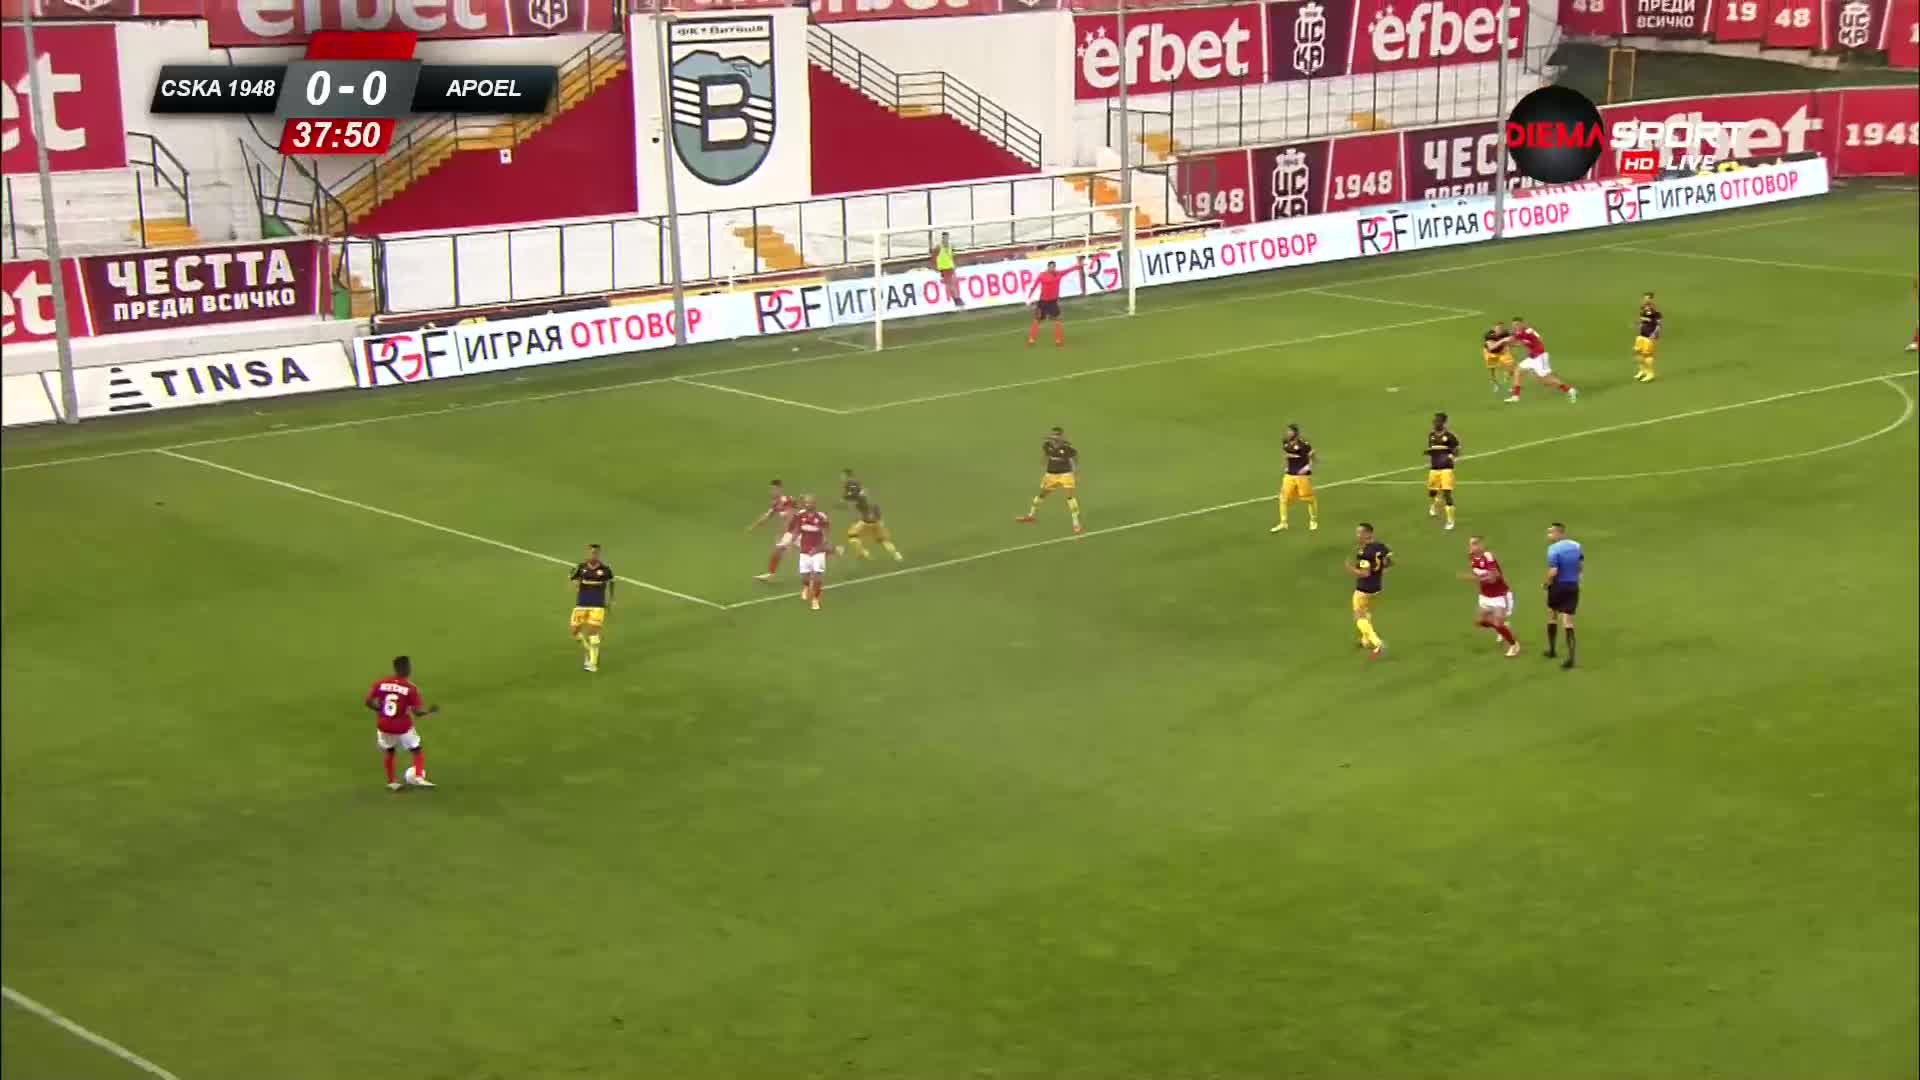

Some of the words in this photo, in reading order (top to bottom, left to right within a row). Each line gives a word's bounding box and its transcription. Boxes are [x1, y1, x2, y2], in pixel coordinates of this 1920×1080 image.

[1372, 1, 1520, 62] efbet
[1637, 15, 1695, 28] ВСИЧКО
[1727, 2, 1757, 22] 19
[1775, 9, 1811, 28] 48
[1083, 17, 1250, 89] efbet
[1334, 170, 1393, 200] 1948
[1661, 183, 1718, 210] ИГРАЯ
[1720, 171, 1799, 201] ОТГОВОР
[1357, 213, 1409, 257] RGF
[1418, 213, 1480, 240] ИГРАЯ
[107, 249, 296, 297] ЧЕСТТА
[1147, 246, 1215, 276] ИГРАЯ
[1221, 232, 1318, 266] ОТГОВОР
[113, 297, 194, 322] ПРЕДИ
[202, 288, 296, 313] ВСИЧКО
[754, 285, 823, 334] RGF
[364, 329, 449, 386] RGF
[465, 325, 563, 364] ИГРАЯ
[151, 357, 310, 397] TINSA
[384, 693, 399, 717] 6
